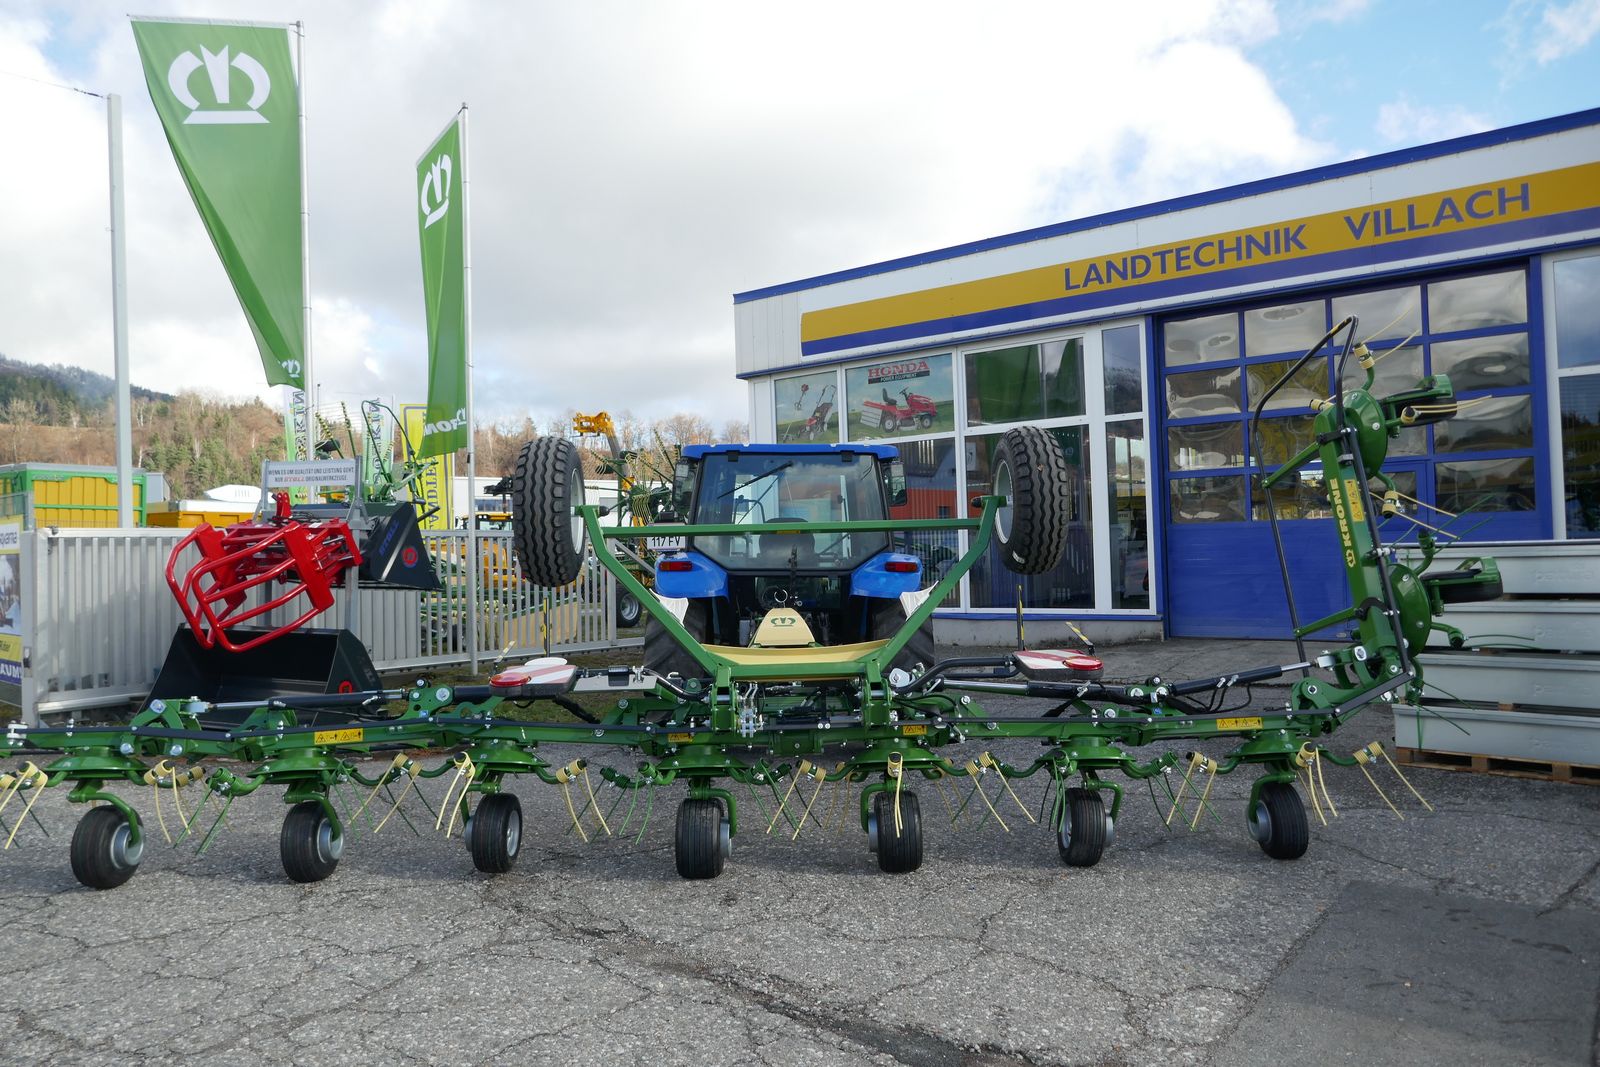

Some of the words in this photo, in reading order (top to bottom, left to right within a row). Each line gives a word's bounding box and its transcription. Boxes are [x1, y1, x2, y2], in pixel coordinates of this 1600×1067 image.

[1064, 224, 1308, 290] LANDTECHNIK
[1344, 183, 1531, 241] VILLACH
[868, 360, 929, 378] HONDA
[1329, 478, 1352, 547] KRONE
